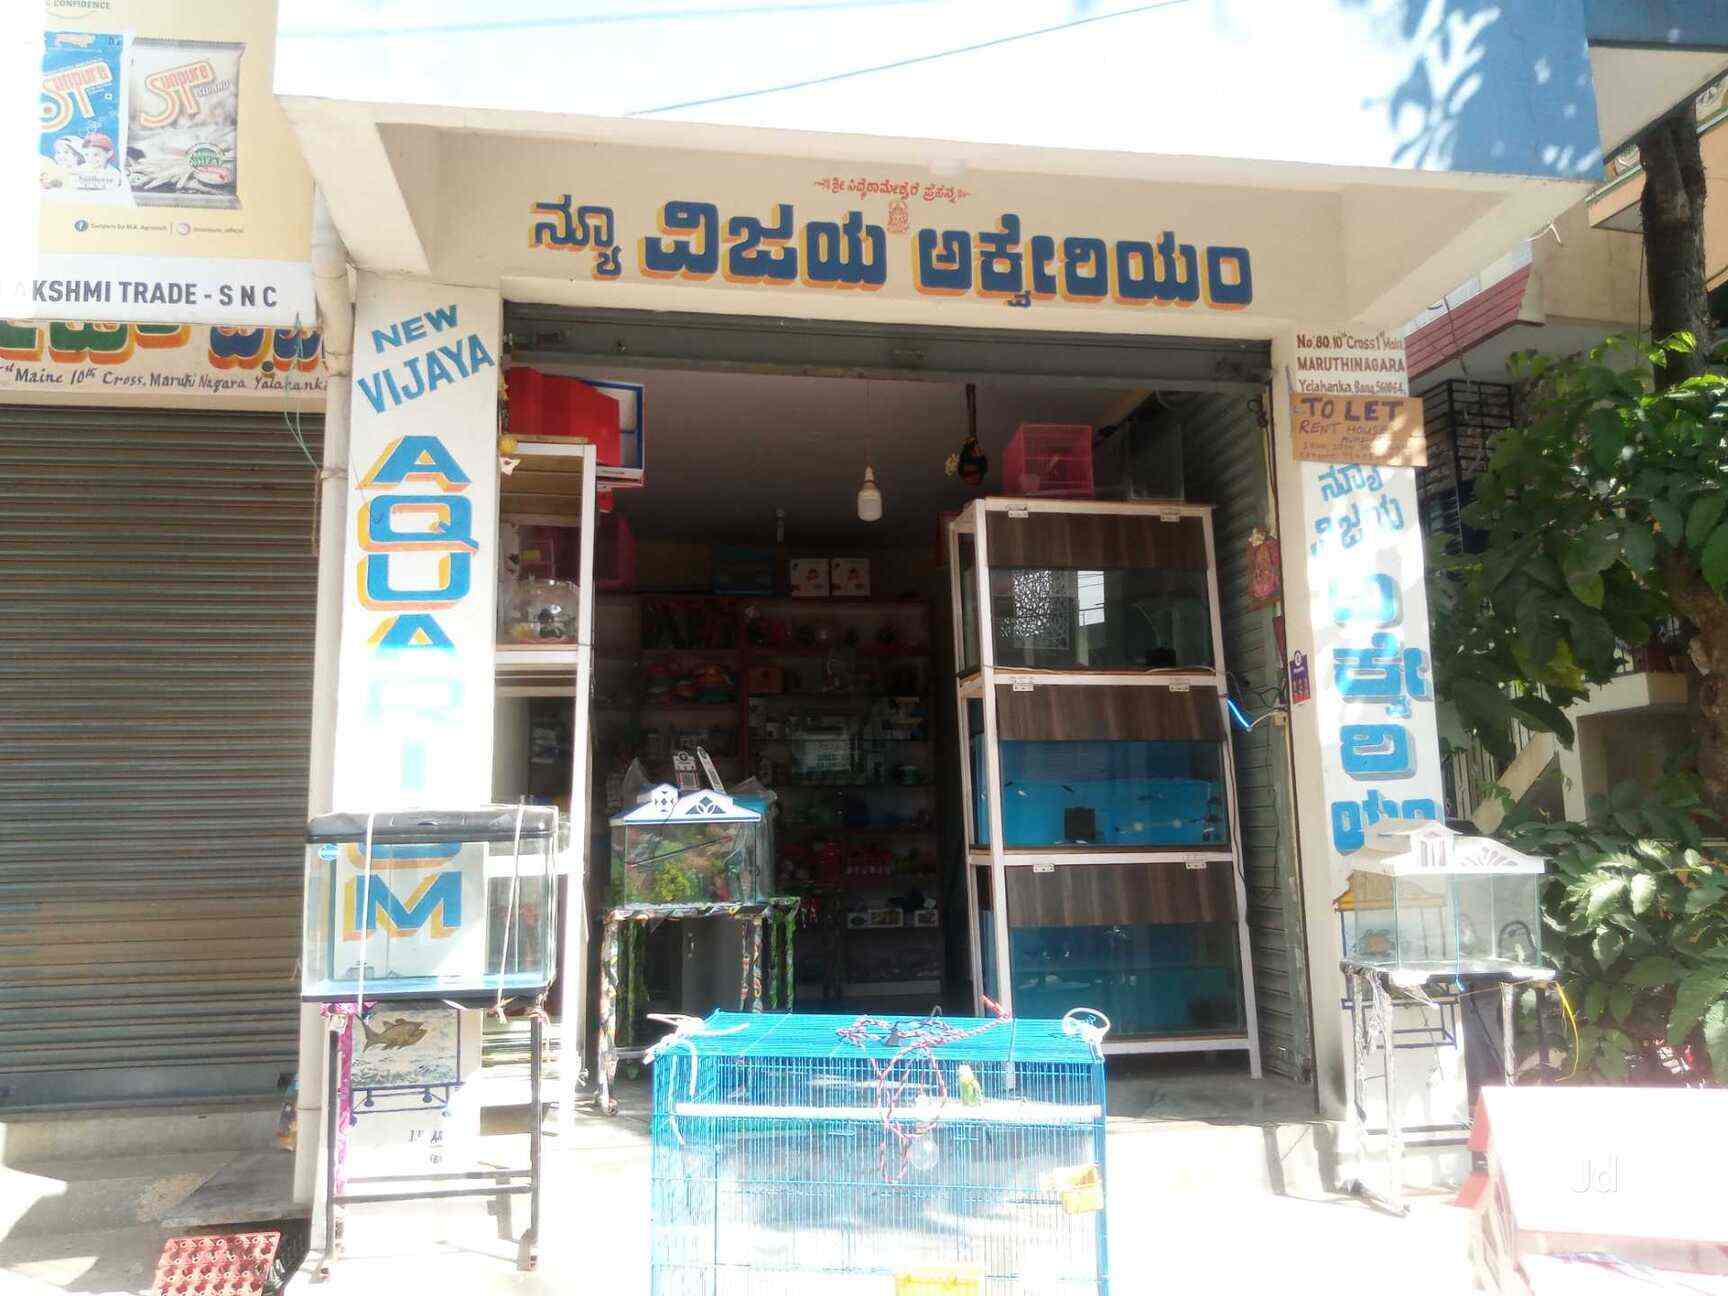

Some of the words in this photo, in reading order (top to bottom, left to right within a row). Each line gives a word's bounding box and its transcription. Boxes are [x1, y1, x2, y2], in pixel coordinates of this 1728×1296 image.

[529, 194, 622, 281] ನ್ಯೂ
[638, 200, 889, 293] ವಿಜಯ
[118, 281, 198, 305] TRADE
[371, 304, 459, 355] NEW
[357, 333, 496, 414] VIJAYA
[1297, 356, 1405, 373] MARUTHINAGARA
[1301, 397, 1335, 419] TO
[1344, 400, 1404, 422] LET
